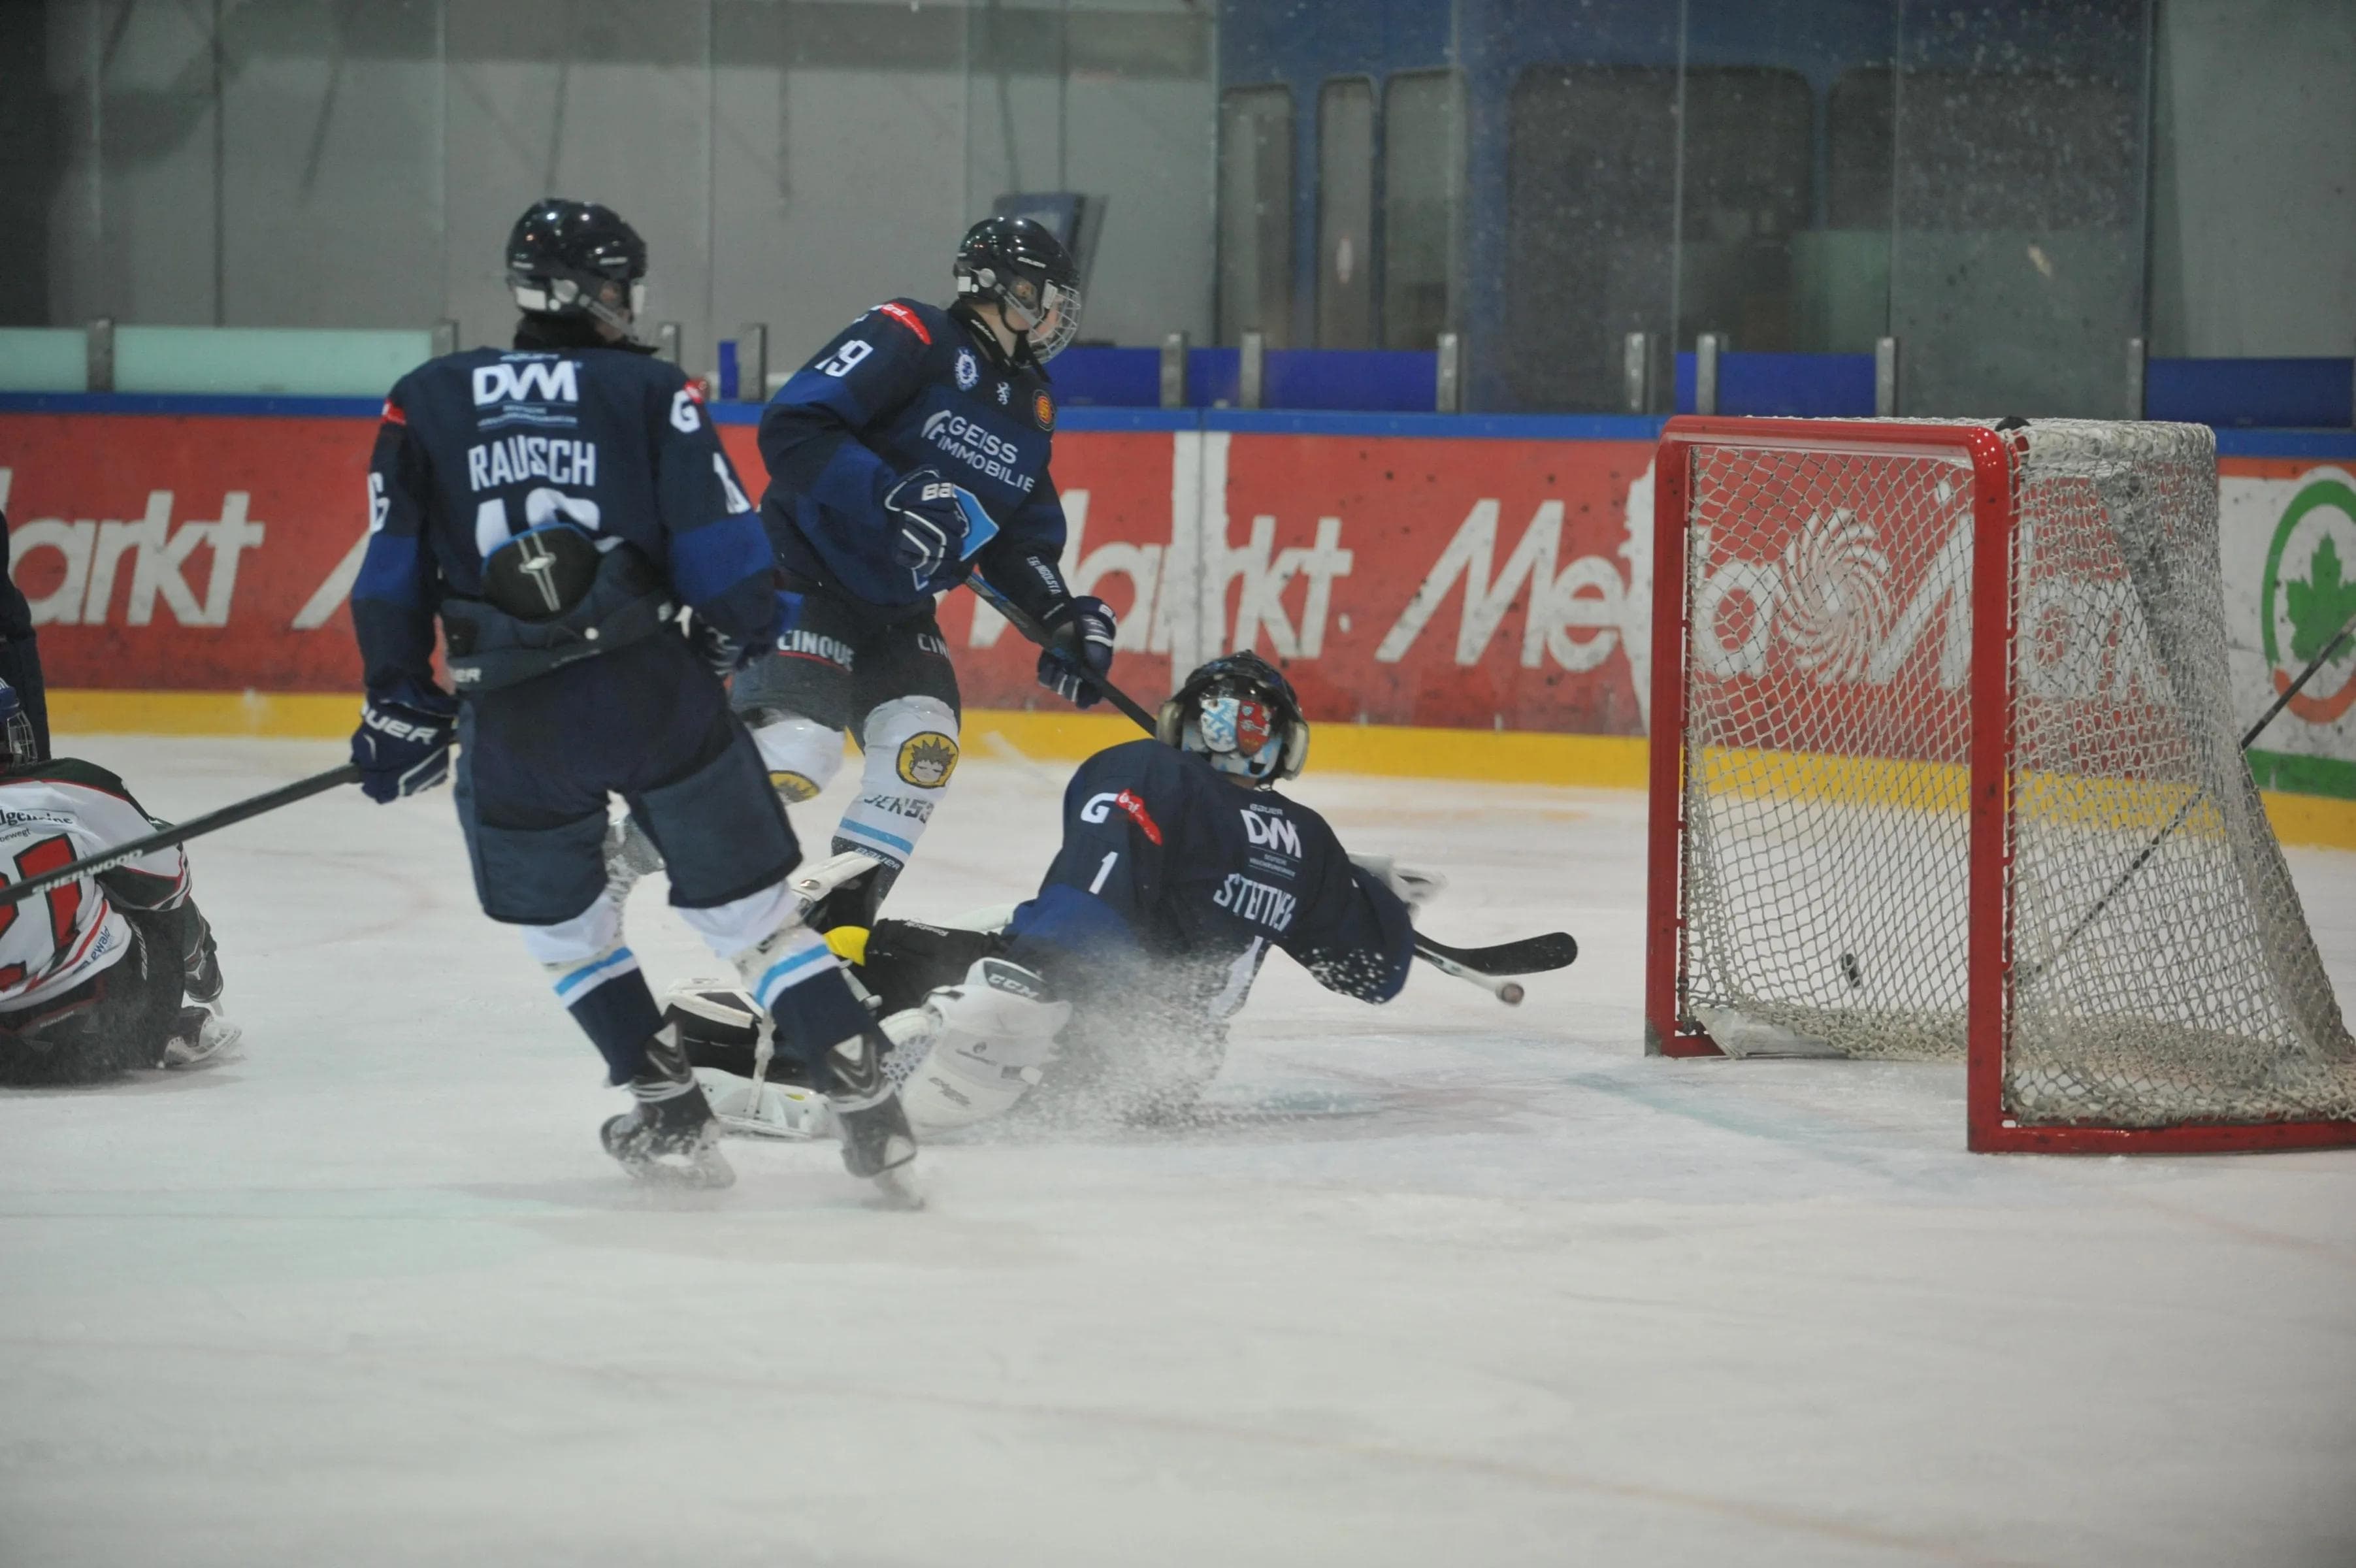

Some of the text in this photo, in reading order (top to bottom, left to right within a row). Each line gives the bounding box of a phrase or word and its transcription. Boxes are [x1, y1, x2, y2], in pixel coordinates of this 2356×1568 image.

[468, 434, 595, 492] RAUSCH
[948, 416, 1019, 465] GEISS
[0, 468, 265, 627] arkt
[777, 629, 854, 672] CINQUE
[361, 702, 438, 745] UER
[1088, 851, 1119, 895] 1
